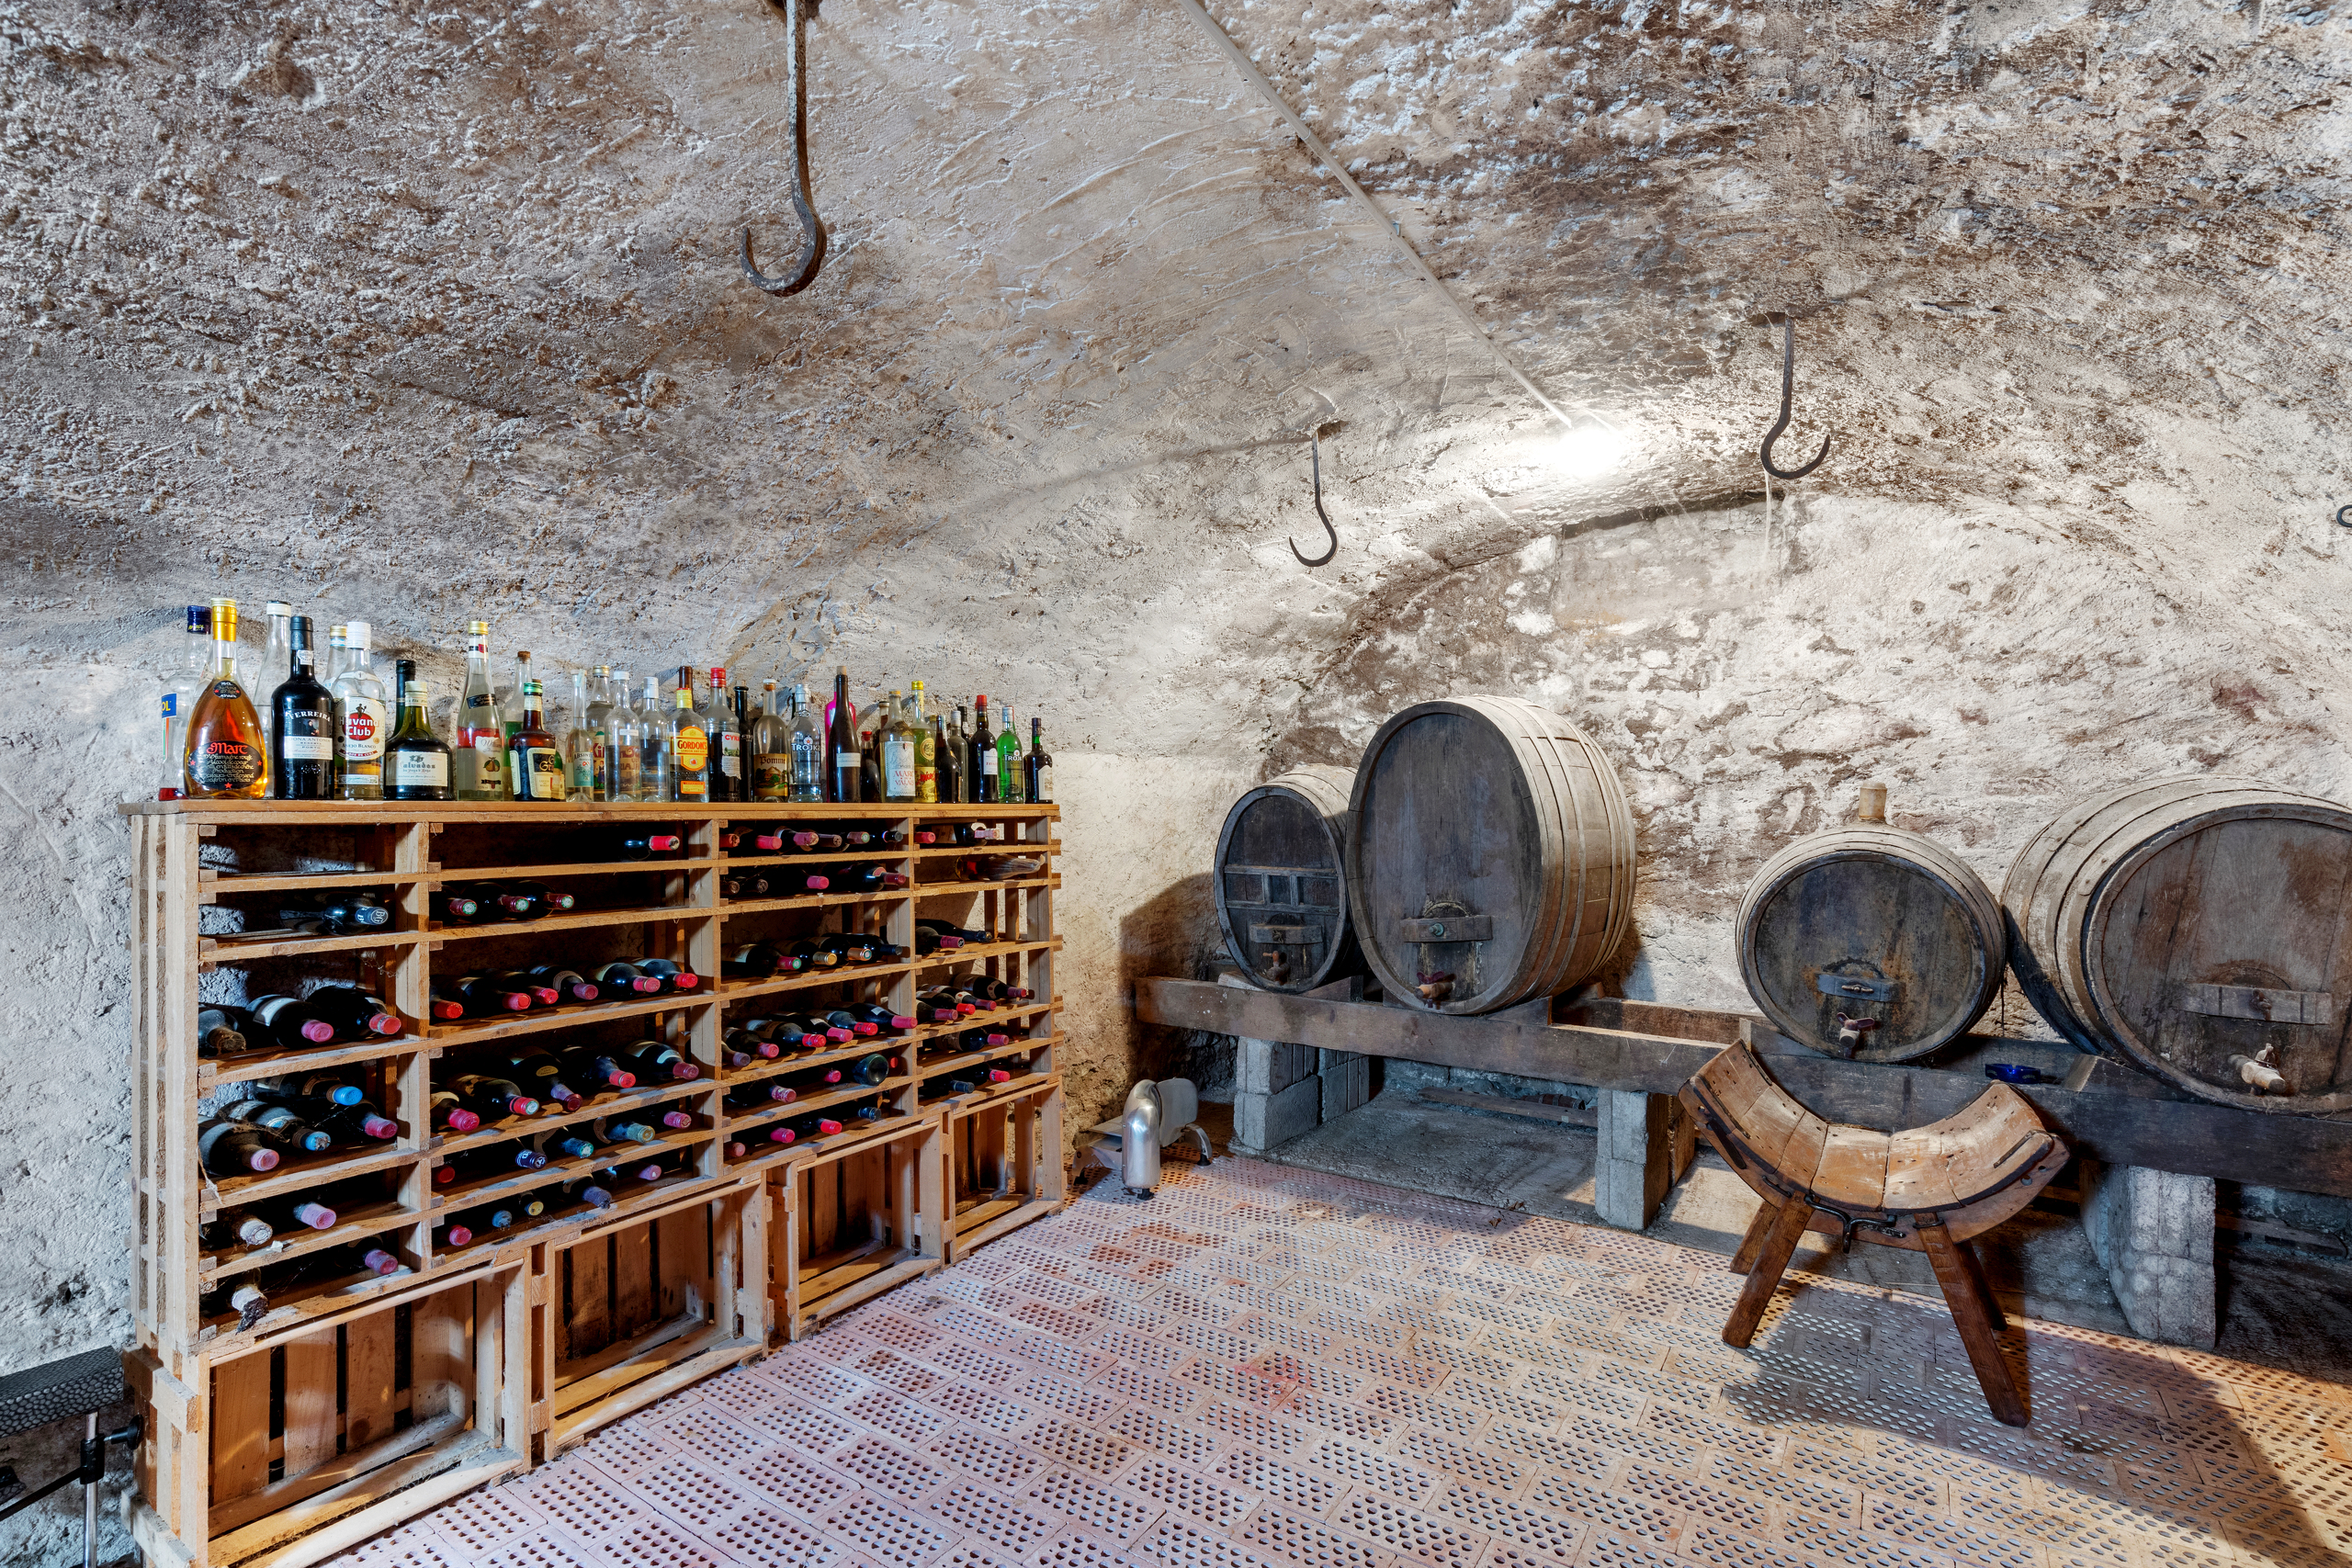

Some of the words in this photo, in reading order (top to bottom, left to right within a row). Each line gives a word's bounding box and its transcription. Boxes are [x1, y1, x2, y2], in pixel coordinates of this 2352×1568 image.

[339, 716, 379, 726] Havana
[348, 726, 371, 736] Club
[206, 742, 248, 754] Marc
[677, 740, 707, 750] GORDON'S
[759, 756, 786, 765] Pomme
